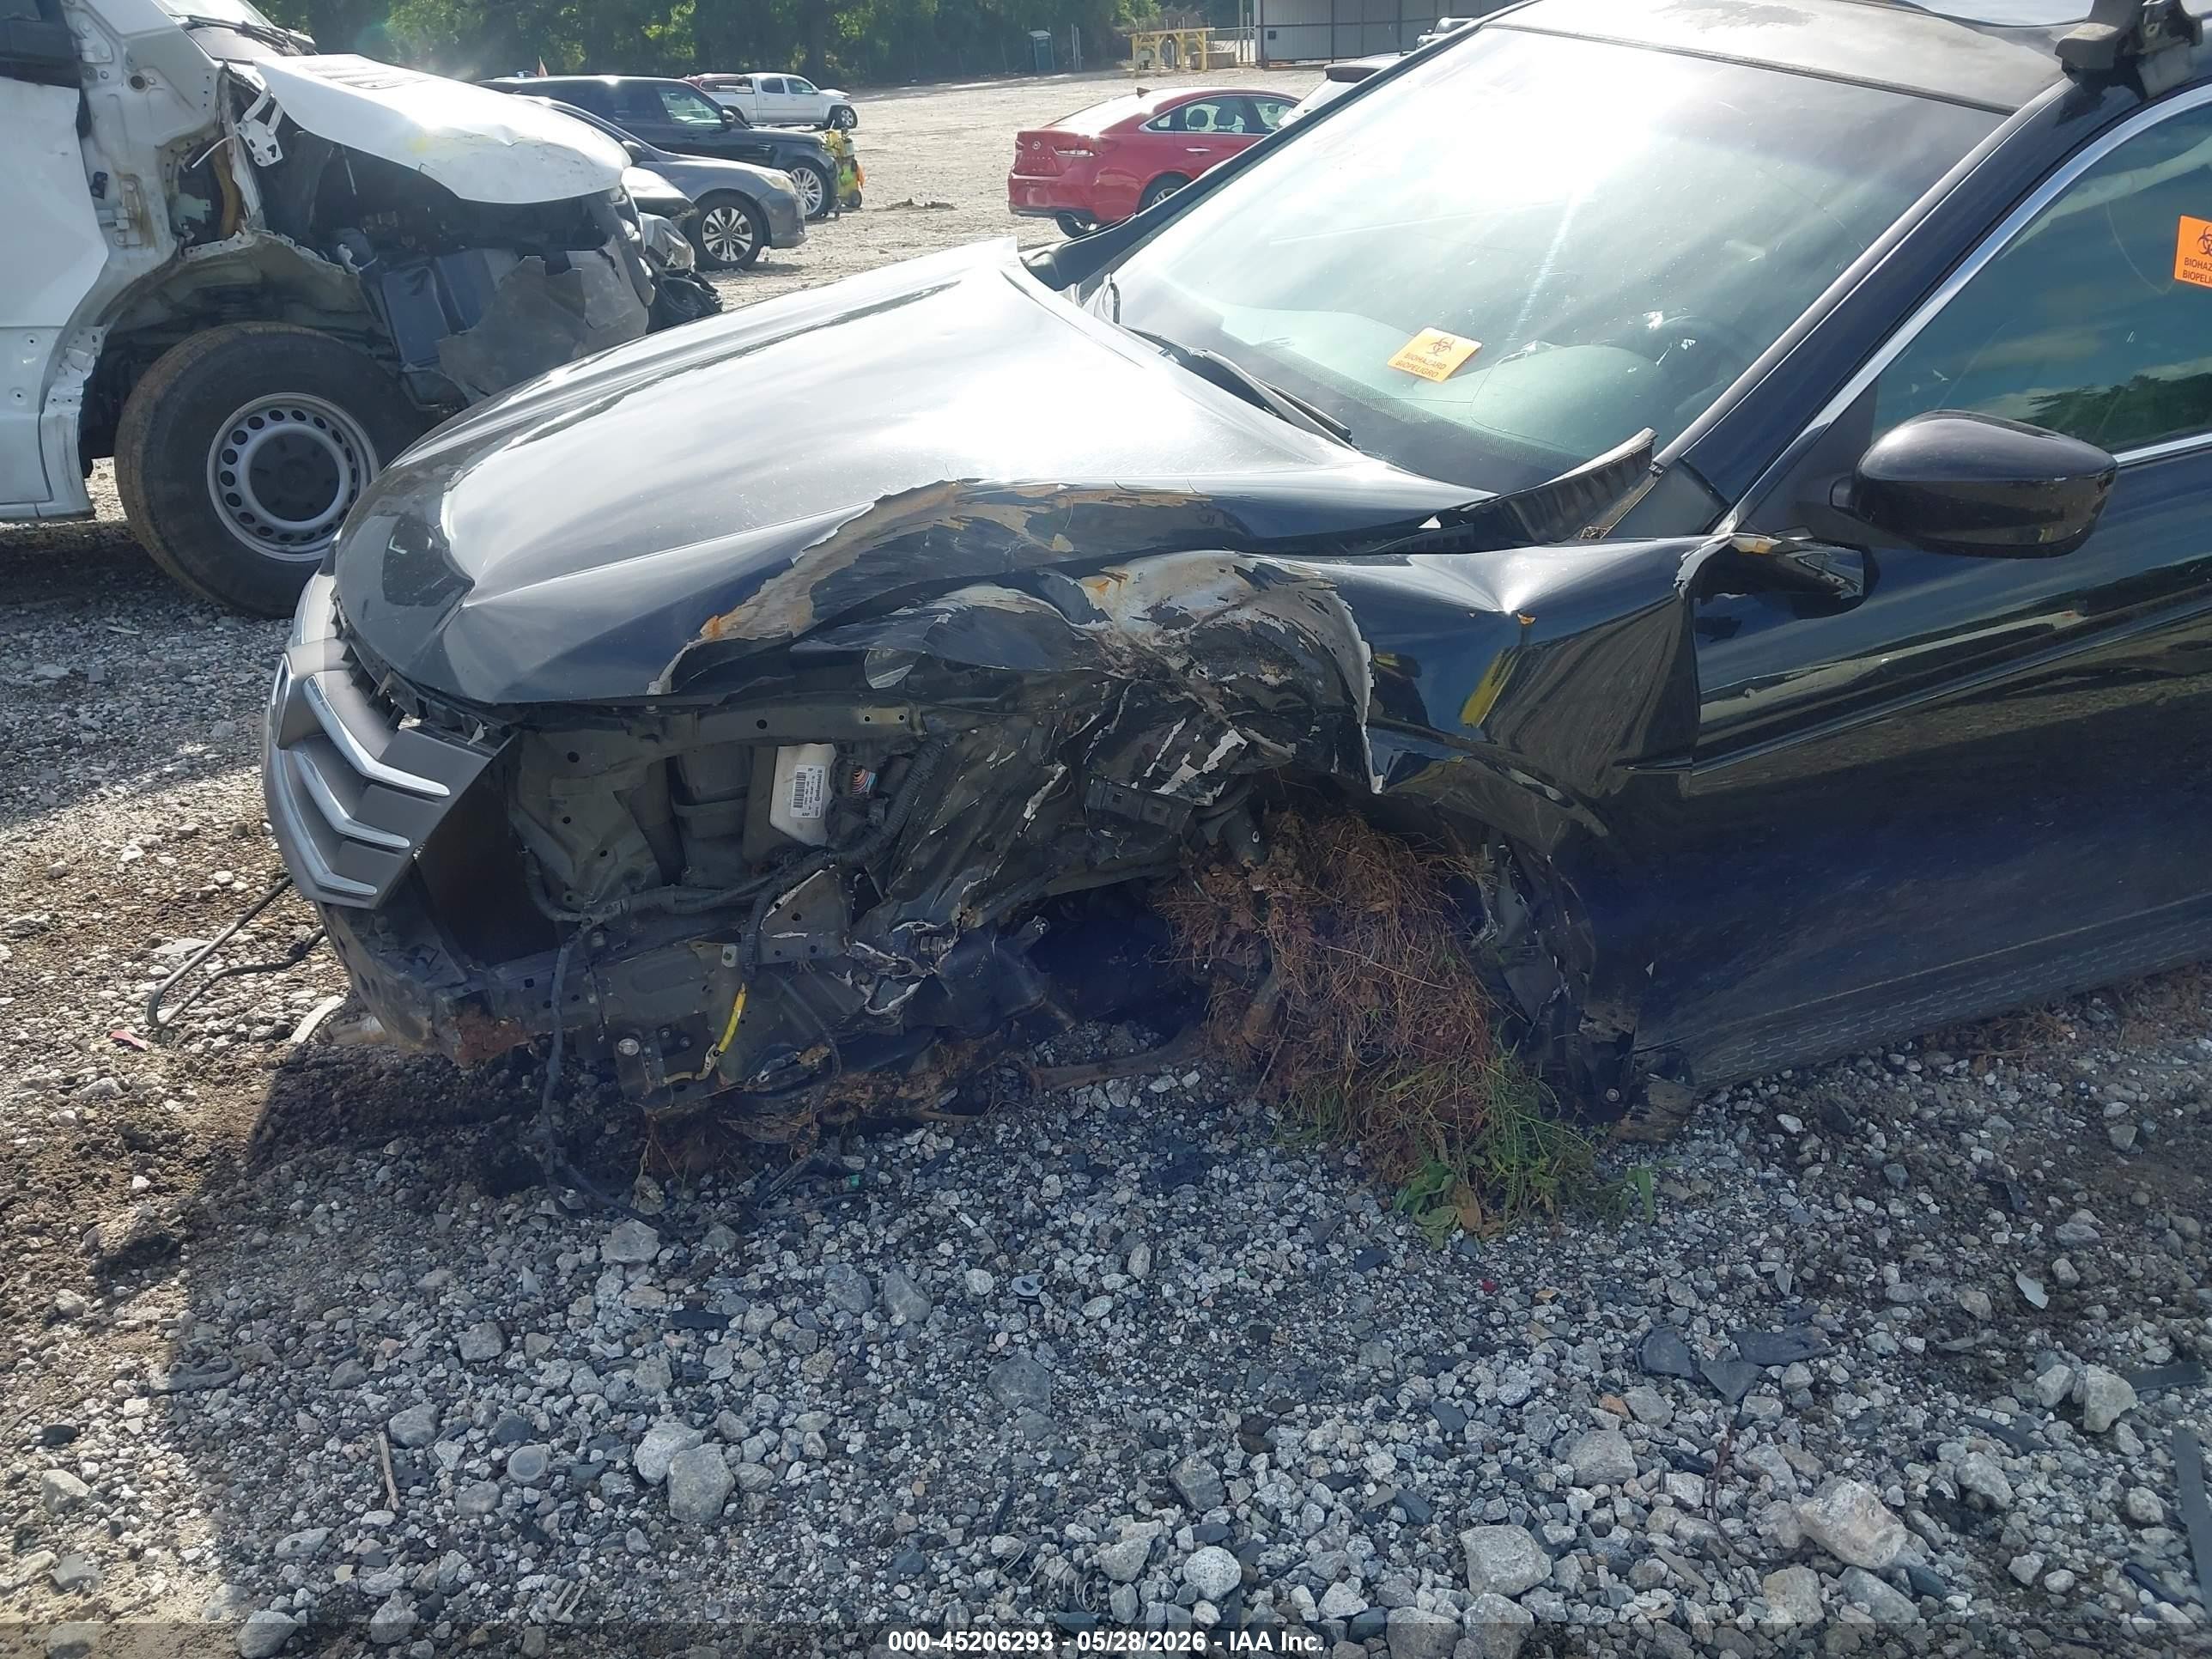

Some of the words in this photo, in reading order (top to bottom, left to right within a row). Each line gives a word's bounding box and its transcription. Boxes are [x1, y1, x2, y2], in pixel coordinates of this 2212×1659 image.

[2182, 270, 2212, 284] BIOPELI
[1395, 359, 1439, 378] BIOPELIGRO
[1404, 352, 1447, 370] BIOHAZARD
